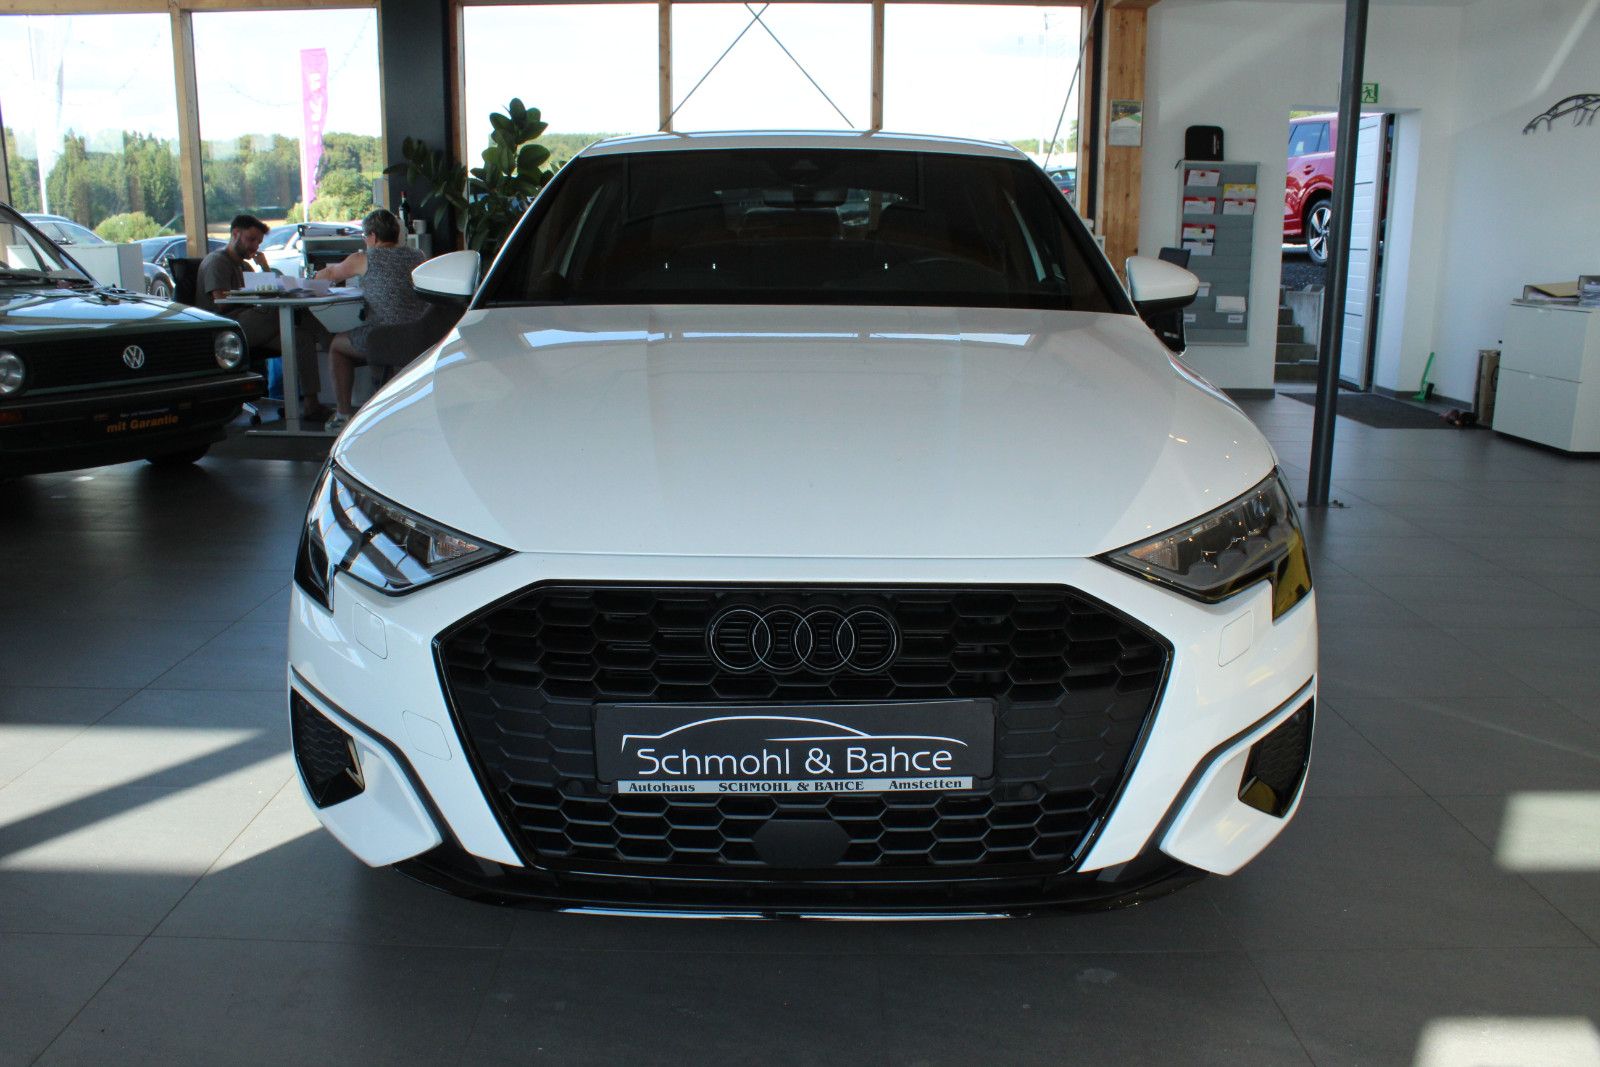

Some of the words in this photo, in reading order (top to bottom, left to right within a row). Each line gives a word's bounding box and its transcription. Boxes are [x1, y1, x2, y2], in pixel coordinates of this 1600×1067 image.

[107, 421, 127, 433] mit
[130, 414, 179, 431] Garantie
[637, 748, 790, 775] Schmohl
[804, 747, 834, 774] &
[846, 746, 953, 774] Bahce
[628, 782, 696, 793] Autohaus
[718, 782, 792, 793] SCHMOHL
[797, 781, 810, 792] &
[814, 780, 864, 792] BAHCE
[888, 778, 962, 790] Amstetten
